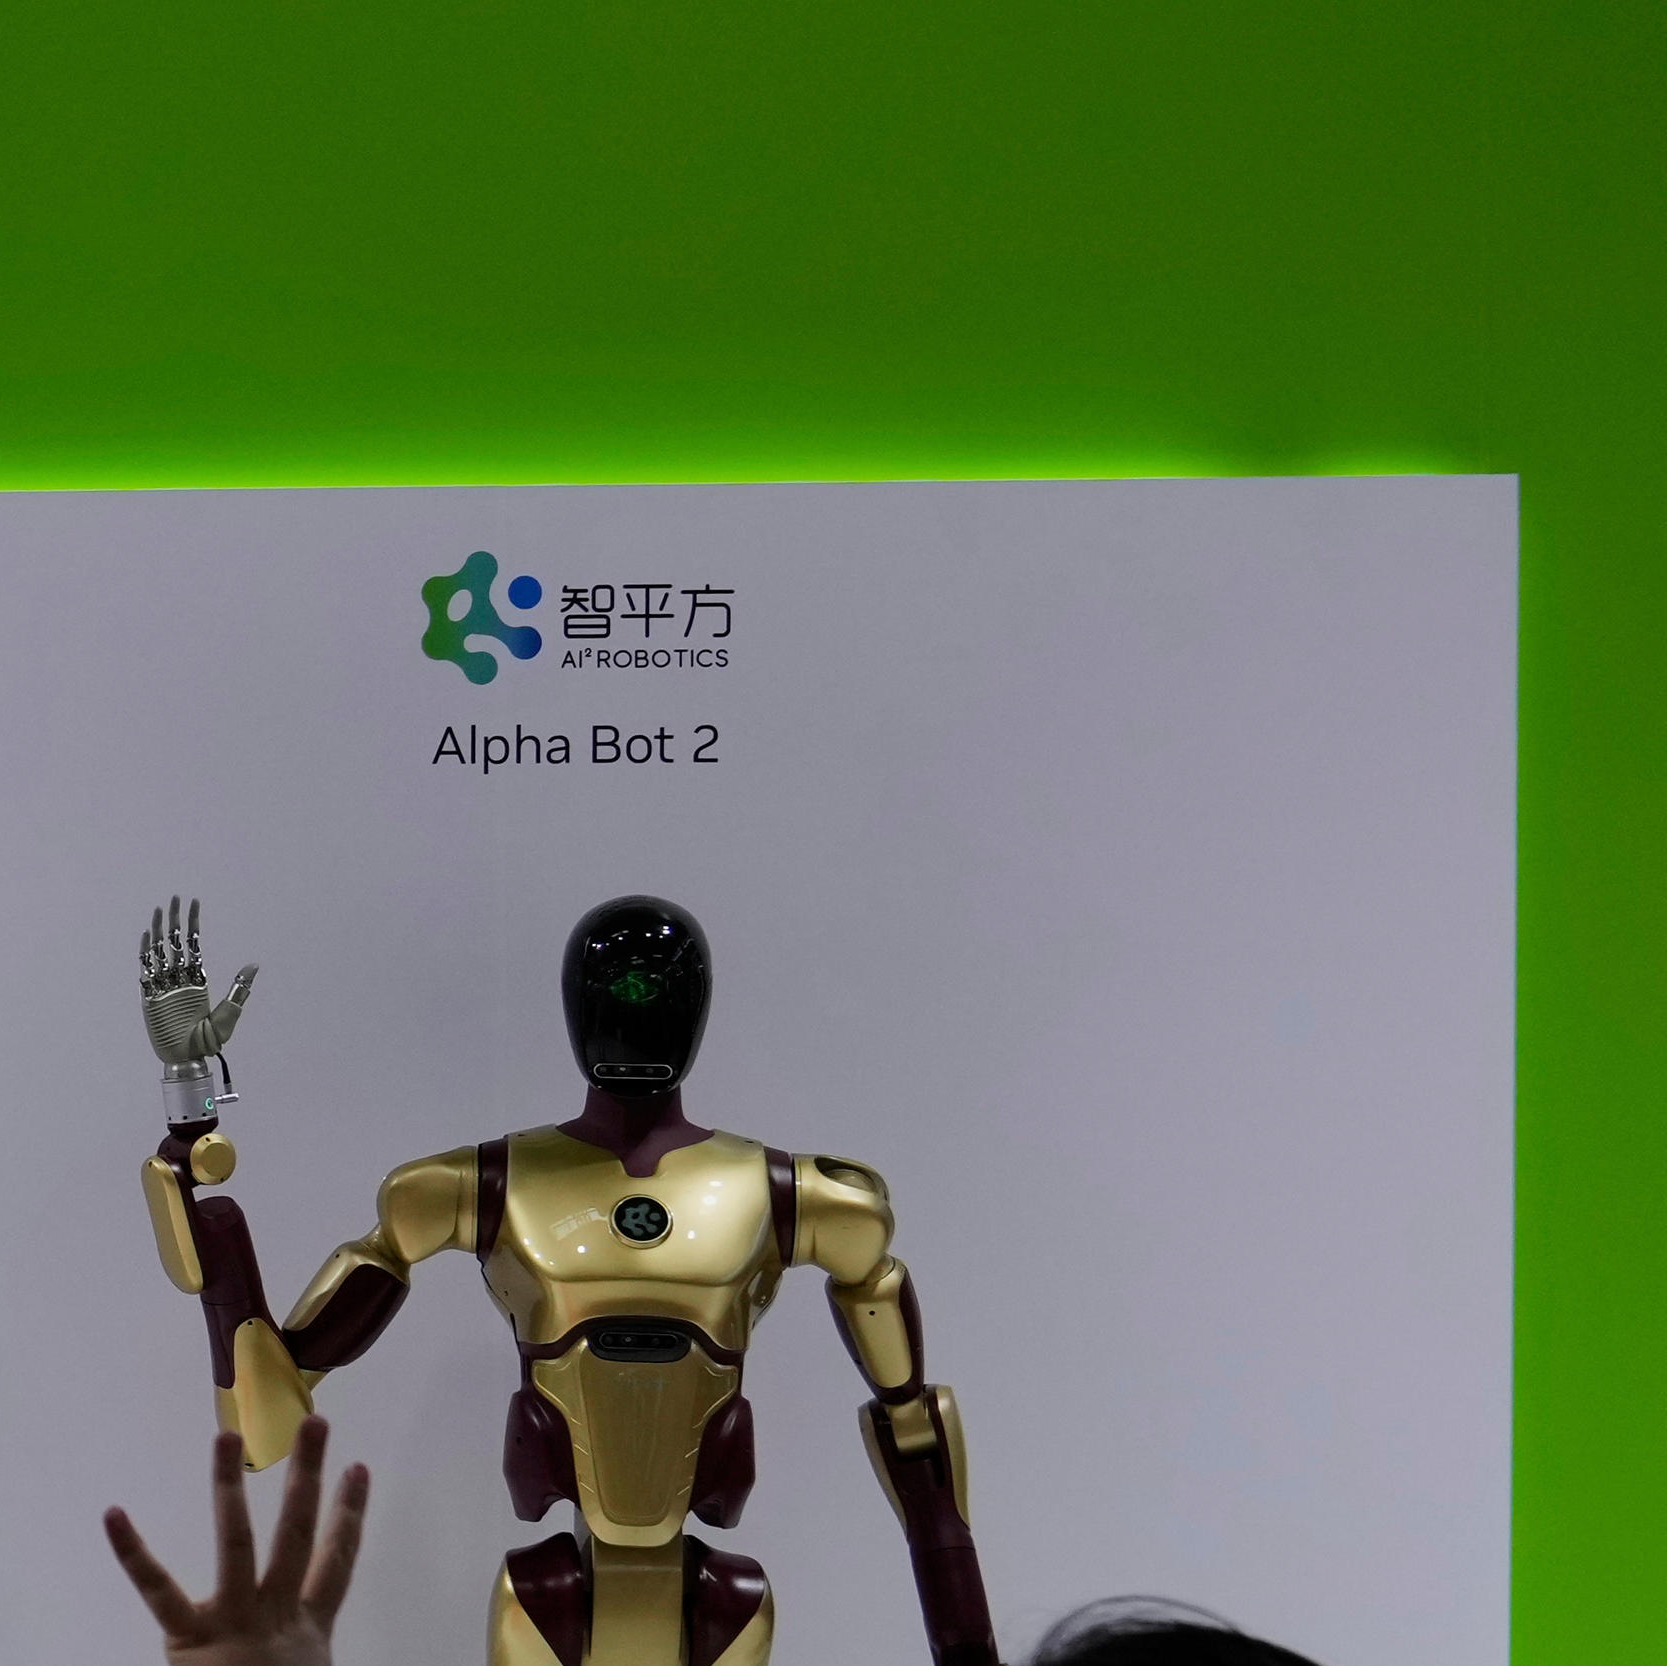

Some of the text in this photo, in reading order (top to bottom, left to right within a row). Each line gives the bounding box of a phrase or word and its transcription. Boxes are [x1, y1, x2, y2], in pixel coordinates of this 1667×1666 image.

[560, 583, 736, 639] 智平方
[432, 724, 719, 774] Alpha Bot 2
